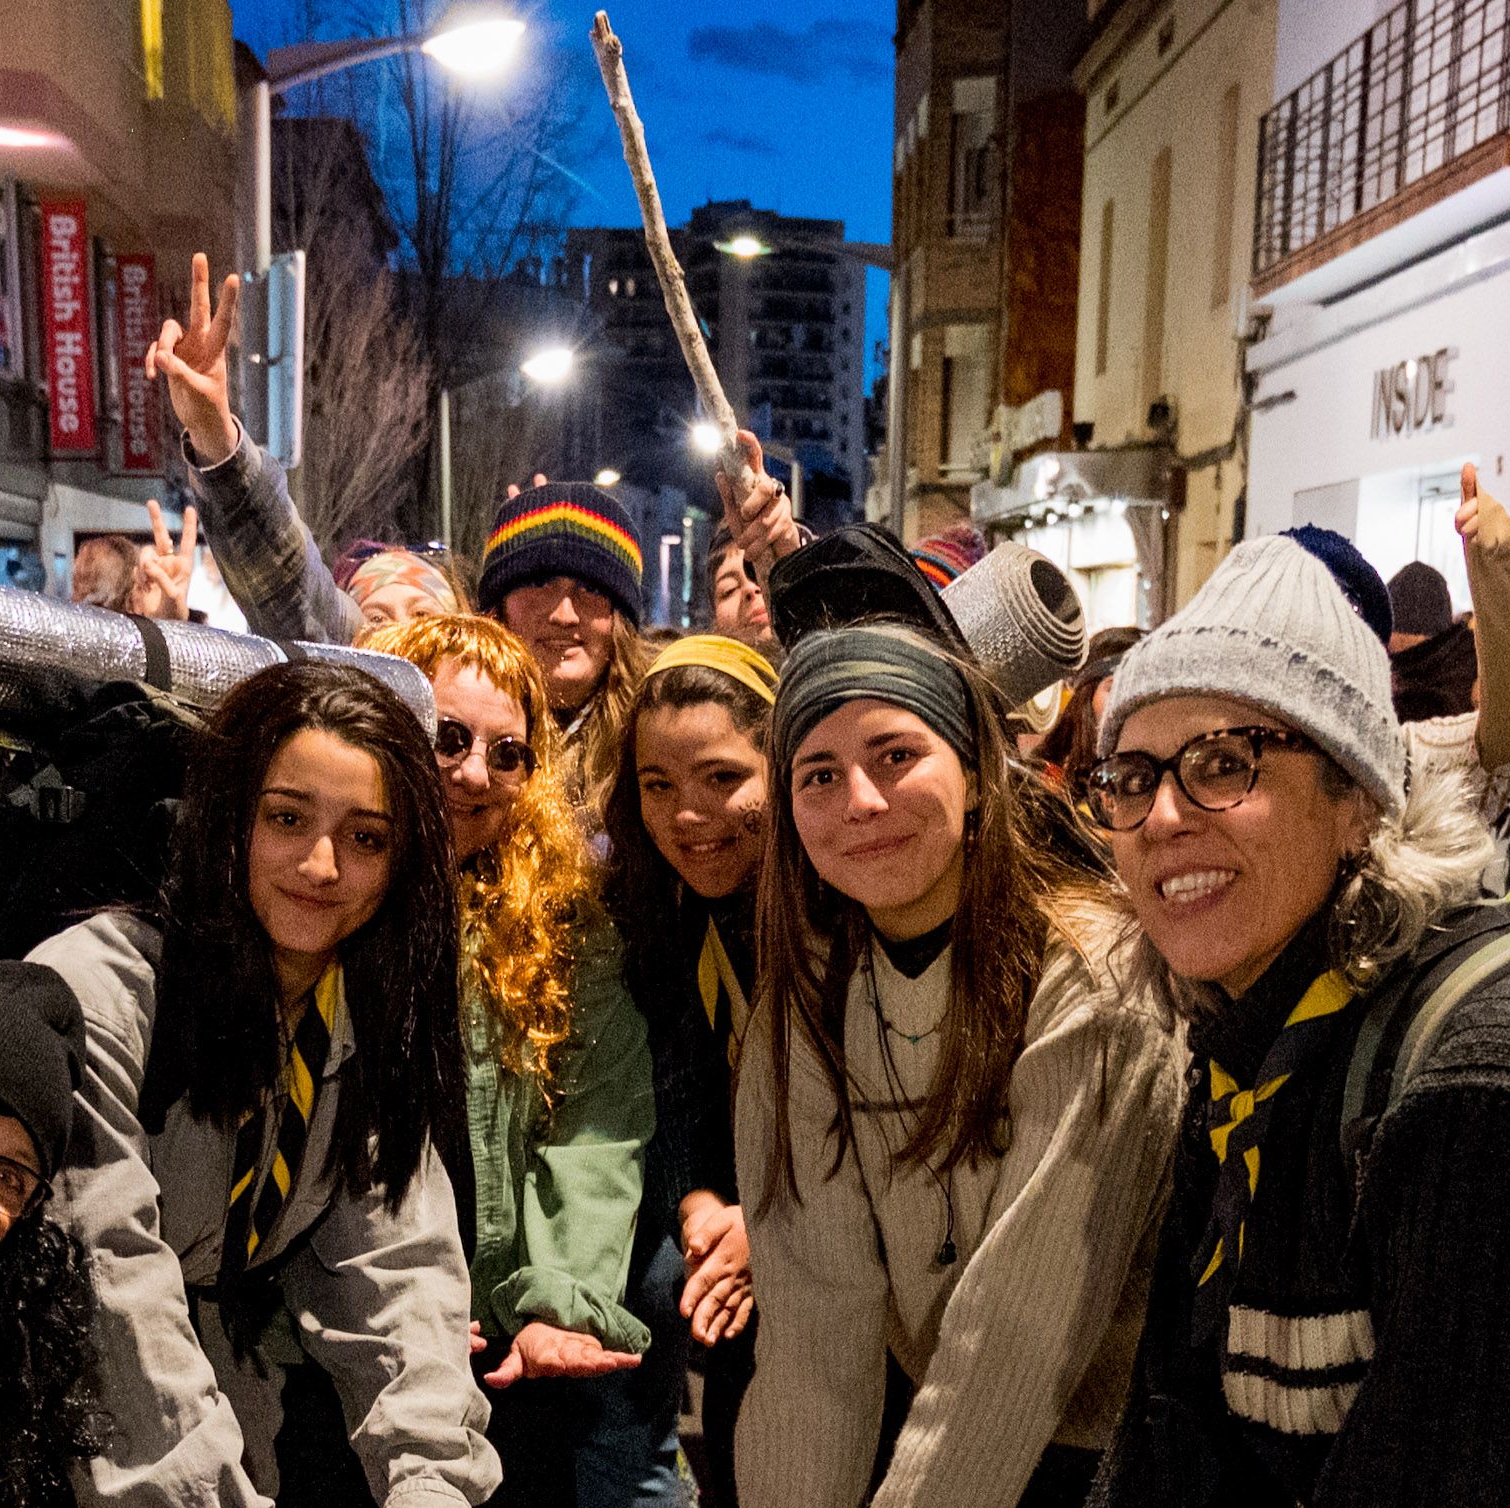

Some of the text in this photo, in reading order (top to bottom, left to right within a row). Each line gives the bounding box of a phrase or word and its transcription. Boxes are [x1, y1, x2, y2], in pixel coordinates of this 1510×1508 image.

[49, 214, 83, 433] British House
[1370, 347, 1458, 439] INSIDE
